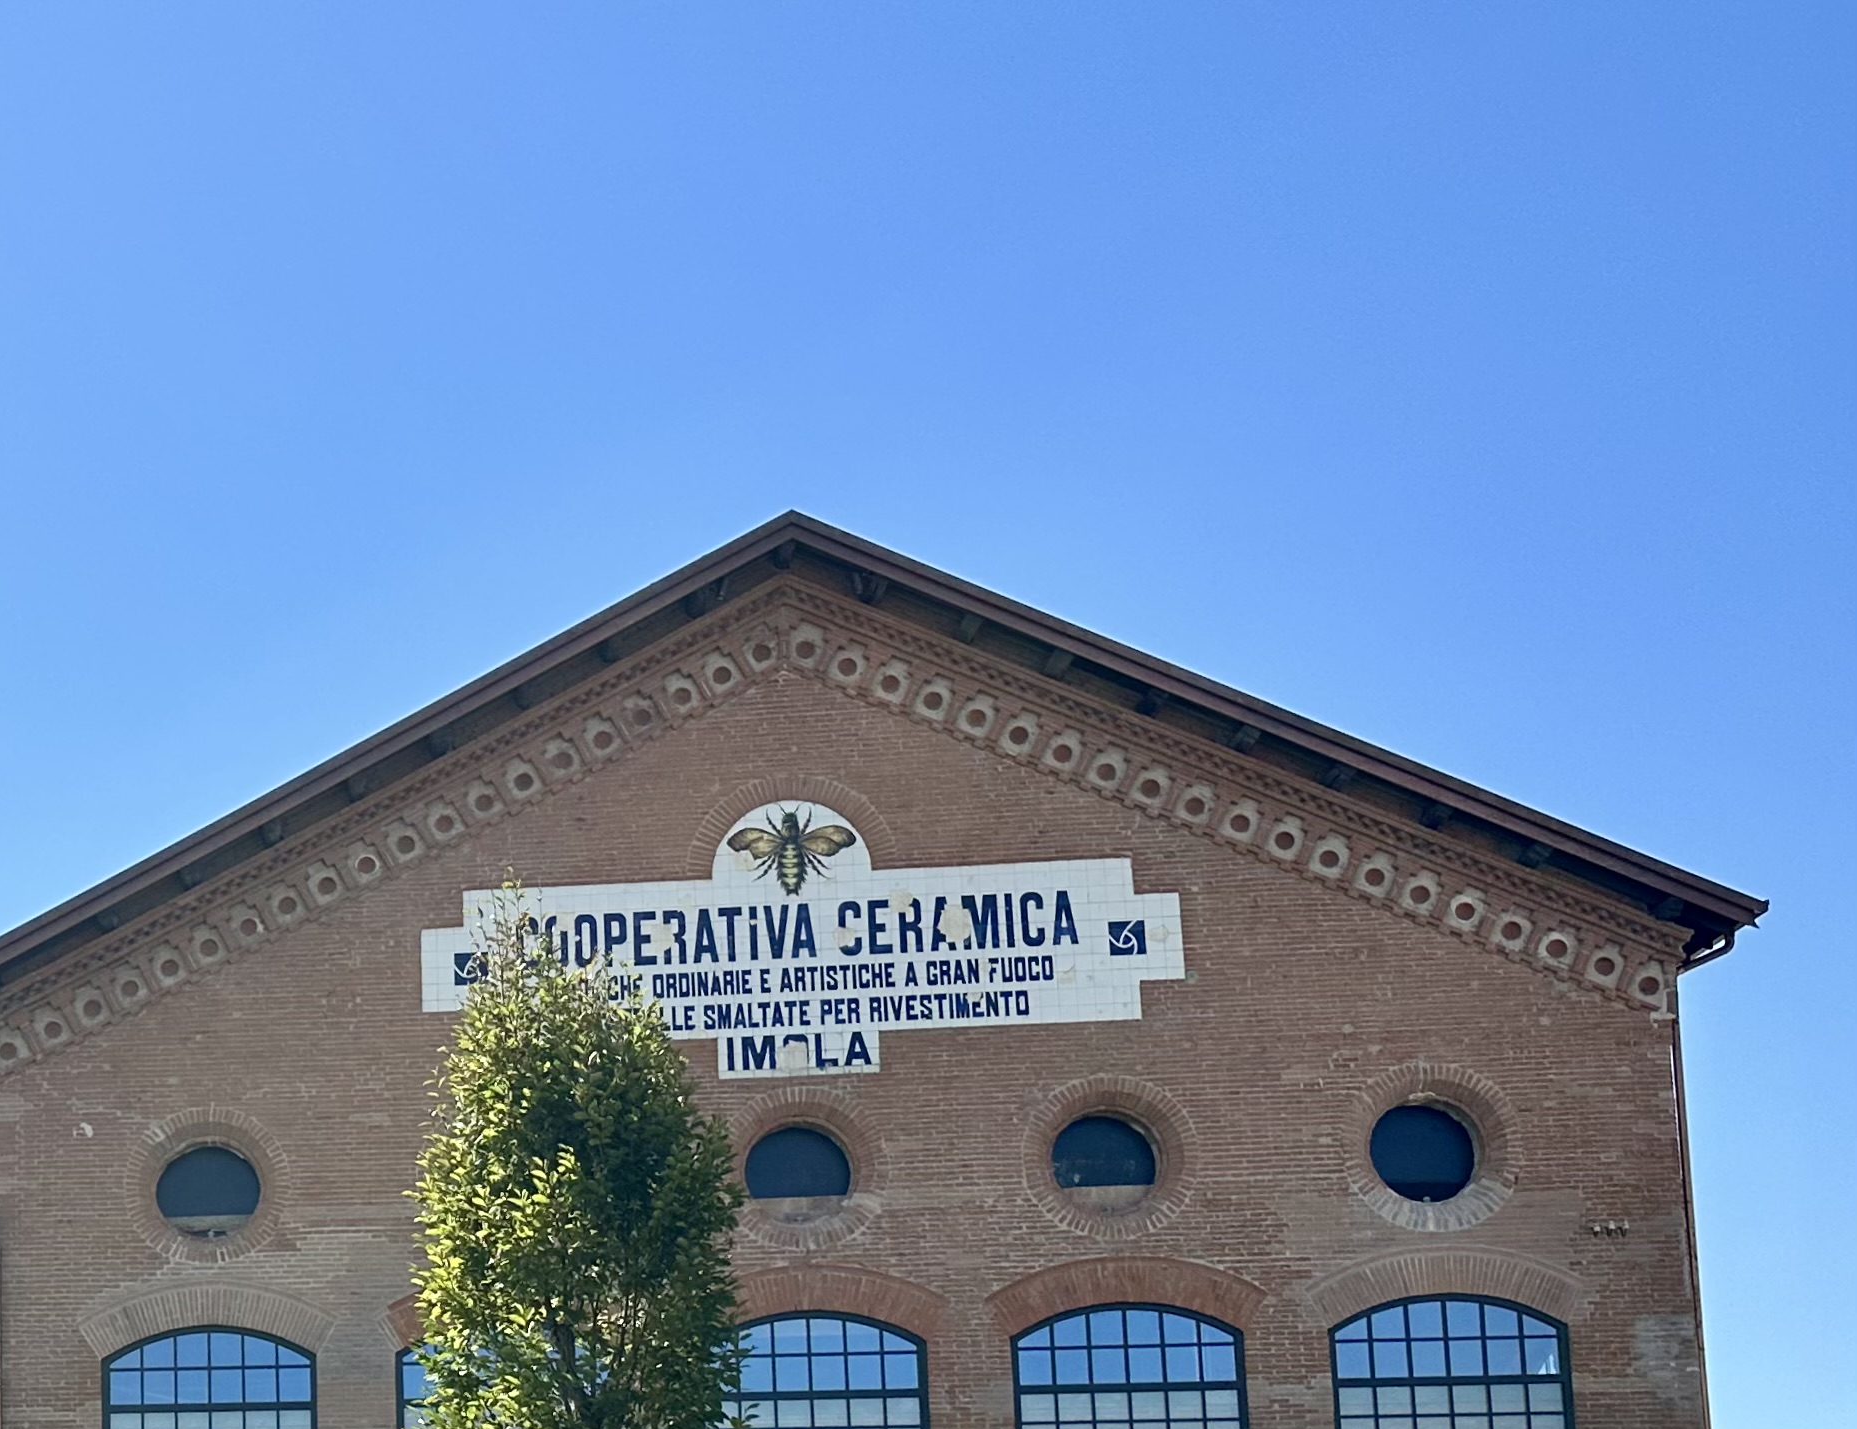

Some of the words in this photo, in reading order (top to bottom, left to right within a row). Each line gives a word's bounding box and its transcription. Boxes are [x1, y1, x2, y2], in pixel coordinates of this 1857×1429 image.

[652, 969, 752, 999] ORDINARIE
[760, 968, 771, 994] E
[780, 962, 896, 993] ARTISTICHE
[904, 961, 919, 987] A
[925, 958, 980, 986] GRAN
[988, 955, 1055, 983] FUOCO
[703, 1000, 811, 1030] SMALTATE
[820, 997, 860, 1025] PER
[869, 990, 1030, 1022] RIVESTIMENTO
